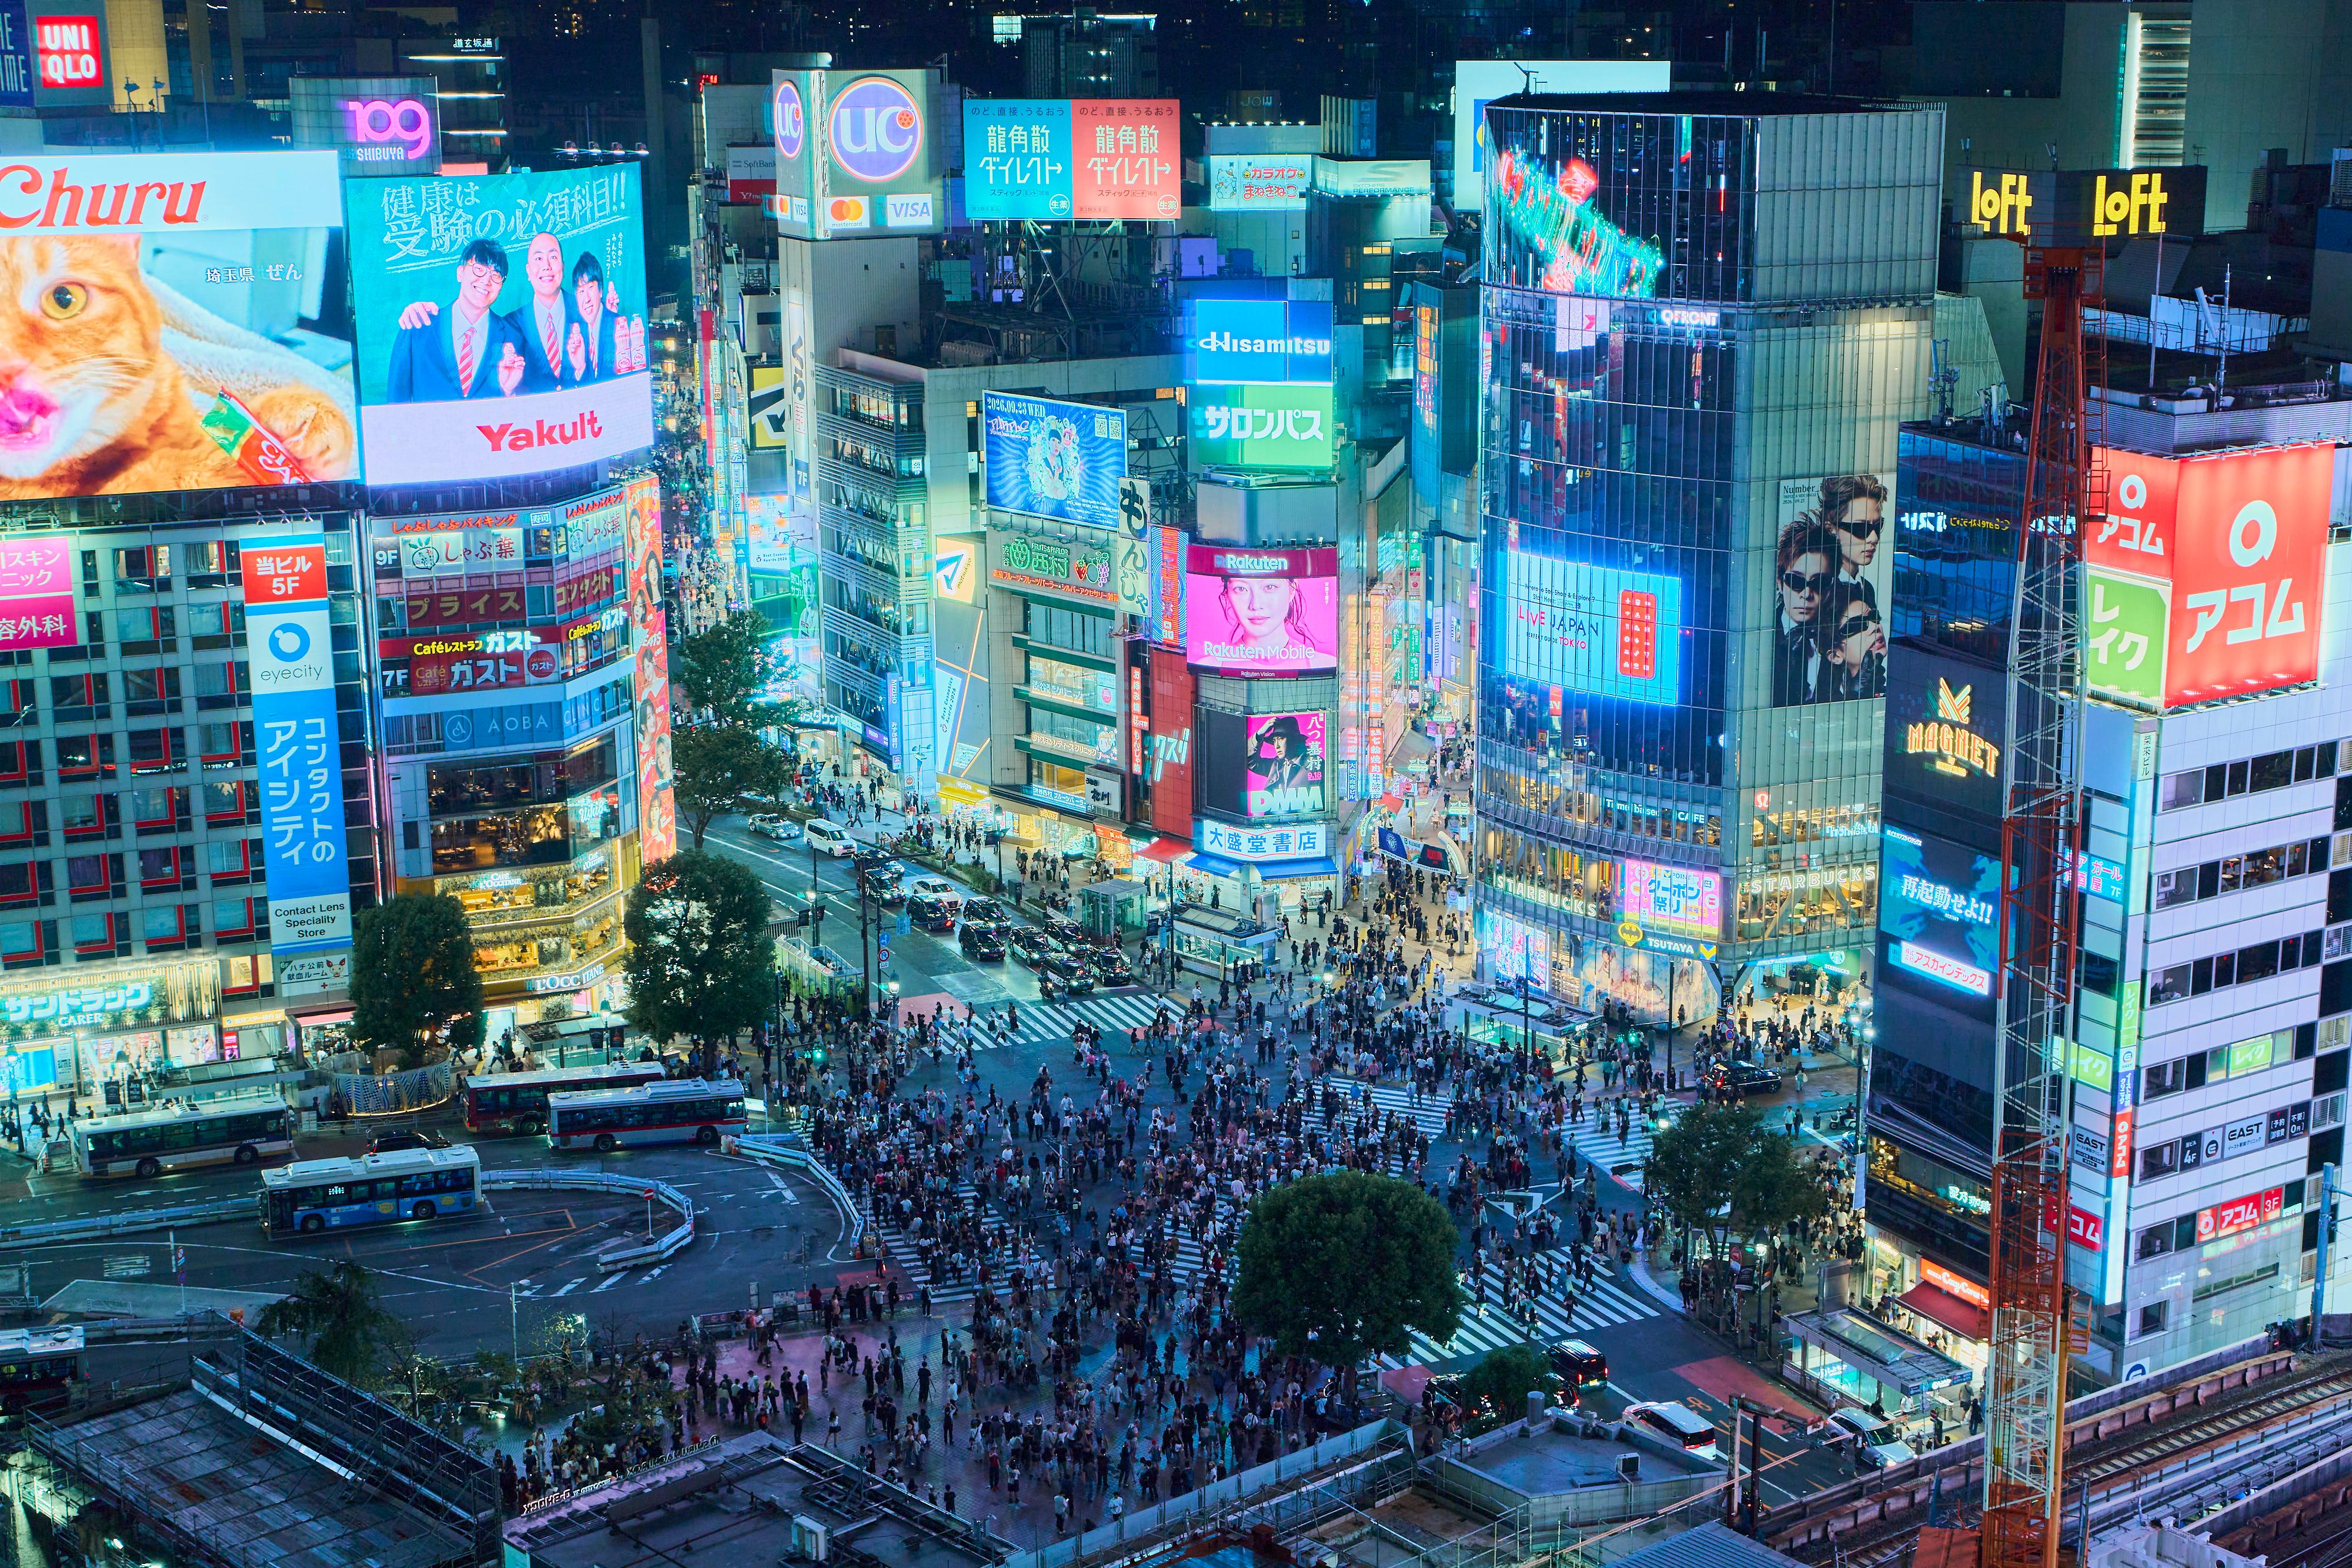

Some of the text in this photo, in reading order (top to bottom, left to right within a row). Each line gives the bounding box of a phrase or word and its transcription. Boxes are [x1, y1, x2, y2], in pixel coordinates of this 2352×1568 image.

[44, 25, 89, 50] UNI
[453, 38, 493, 48] 道玄坂通
[48, 54, 96, 83] QLO
[971, 106, 1065, 116] のど、直接、うるおう
[1079, 106, 1174, 116] のど、直接、うるおう
[349, 100, 430, 159] 109
[987, 125, 1050, 154] 龍角散
[1095, 125, 1160, 154] 龍角散
[357, 147, 405, 161] SHIBUYA
[743, 160, 776, 169] SoftBank
[978, 157, 1063, 185] ダイレクト
[1087, 157, 1171, 185] ダイレクト
[1251, 168, 1298, 179] カラオケ
[0, 165, 207, 228] Churu
[381, 182, 480, 221] 健康は
[1243, 183, 1298, 200] まねきねこ
[795, 203, 807, 218] VISA
[889, 202, 931, 219] VISA
[1050, 199, 1068, 210] 生薬
[1159, 199, 1178, 210] 生薬
[206, 263, 303, 283] 埼玉県 ぜん
[1661, 309, 1718, 326] QFRONT
[987, 397, 1045, 417] 2026.09.23 WED
[476, 410, 602, 452] Yakult
[1205, 406, 1324, 442] サロンパス
[797, 470, 807, 486] 7F
[566, 491, 625, 519] しゃぶしゃぶバイキング
[392, 514, 518, 534] しゃぶしゃぶバイキング
[532, 513, 549, 524] 寿司
[2097, 513, 2164, 555] アコム
[445, 536, 515, 562] しゃぶ葉
[1003, 545, 1010, 567] 渋谷
[1032, 543, 1069, 556] FRUITS&PARLOR
[1120, 480, 1148, 613] もんじゃ
[0, 549, 61, 568] スキン
[256, 555, 312, 576] 当ビル
[375, 550, 398, 566] 9F
[1032, 552, 1068, 579] 西村
[1225, 556, 1288, 572] Rakuten
[957, 558, 973, 589] matsukiyo
[272, 577, 300, 596] 5F
[557, 571, 610, 607] コンタクト
[409, 591, 521, 620] プライス
[601, 607, 627, 633] ガスト
[1518, 605, 1598, 637] LIVE JAPAN
[2187, 579, 2306, 654] アコム
[2090, 584, 2149, 671] レイク
[486, 631, 540, 653] ガスト
[1204, 641, 1315, 660] Rakuten Mobile
[1559, 637, 1586, 649] TOKYO
[253, 664, 324, 684] eyecity
[382, 670, 409, 687] 7F
[416, 666, 446, 678] Café
[450, 658, 517, 688] ガスト
[417, 678, 446, 687] レストラン
[943, 677, 954, 707] Cosmetics
[488, 714, 548, 733] AOBA
[1306, 716, 1323, 771] 八つ墓村
[1907, 722, 1999, 777] MAGNET
[1154, 728, 1190, 782] クスリ
[1308, 771, 1322, 780] 9.18
[264, 720, 305, 865] アイシティ
[304, 717, 336, 862] コンタクトの
[1251, 786, 1323, 814] DMM
[1210, 828, 1317, 852] 大盛堂書店
[1752, 866, 1876, 893] STARBUCKS
[2092, 861, 2123, 881] ガール
[1498, 875, 1596, 918] STARBUCKS
[1648, 879, 1700, 900] クーポン
[1901, 874, 1993, 924] 再起動せよ!!
[2111, 885, 2122, 898] 7F
[275, 902, 345, 917] Contact Lens
[1654, 896, 1681, 914] 祭り
[285, 914, 336, 928] Speciality
[298, 927, 325, 938] Store
[1647, 938, 1694, 954] TSUTAYA
[287, 970, 328, 981] 献血ルーム
[290, 961, 324, 971] ハチ公前
[1825, 964, 1850, 975] STARBUCKS
[1915, 951, 1984, 989] アスカインデックス
[2124, 988, 2134, 1021] レイク
[2236, 1044, 2264, 1065] レイク
[2228, 1122, 2263, 1141] EAST
[2076, 1133, 2106, 1152] EAST
[2116, 1134, 2127, 1168] アコム
[2184, 1149, 2197, 1164] 4F
[1948, 1185, 1992, 1214] 星乃珈琲
[2265, 1196, 2280, 1212] 3F
[2221, 1202, 2258, 1229] アコム
[1926, 1269, 1941, 1281] GINZA
